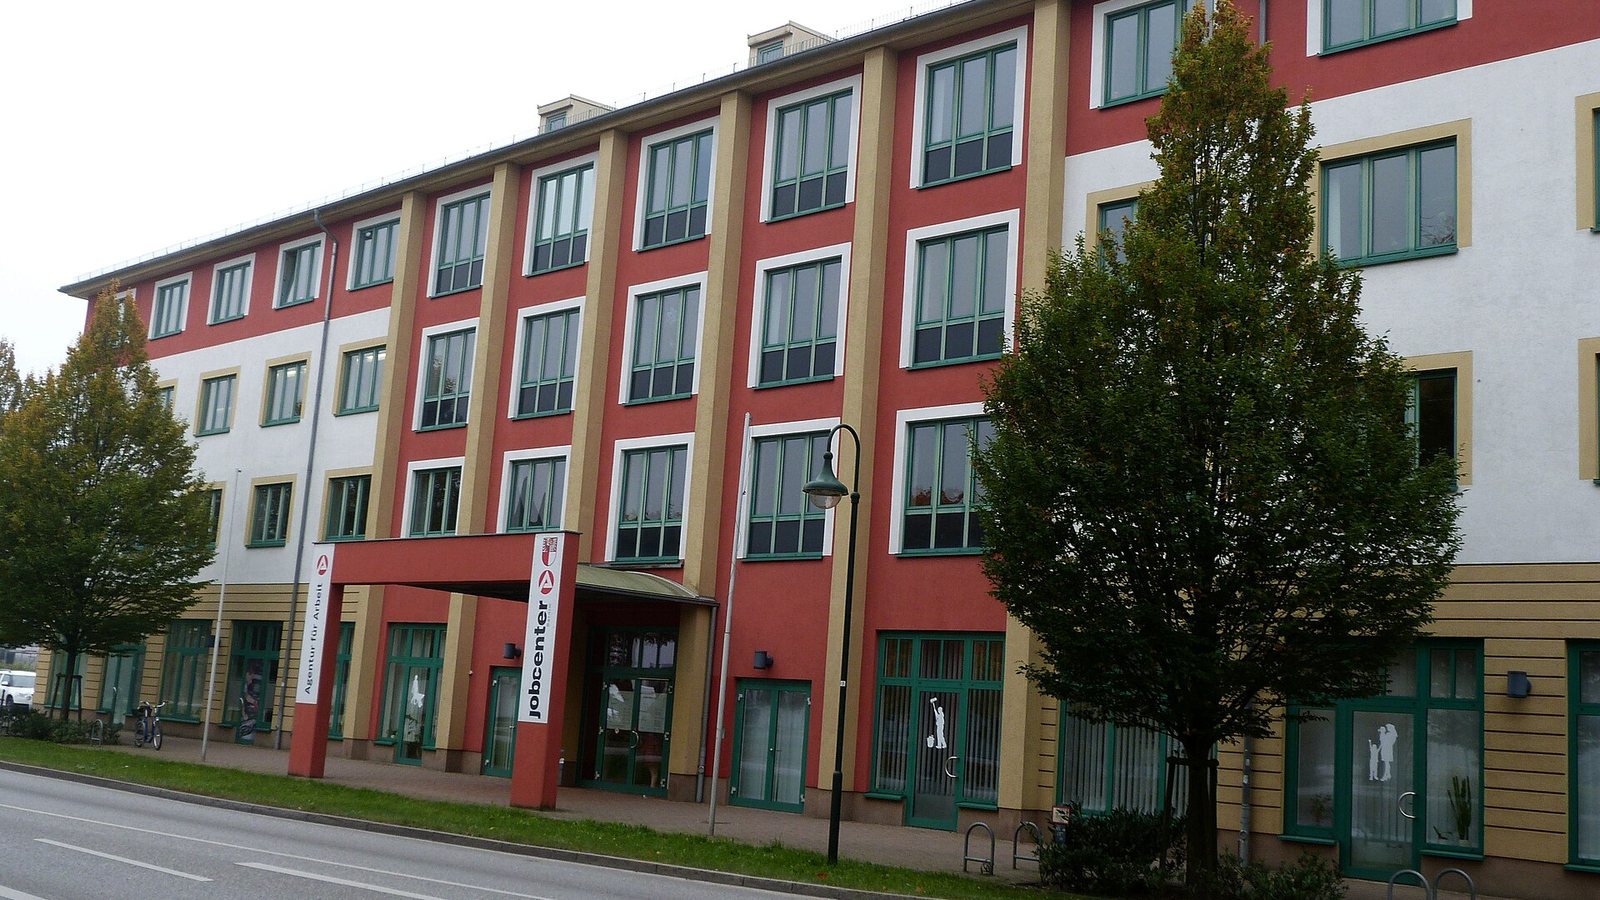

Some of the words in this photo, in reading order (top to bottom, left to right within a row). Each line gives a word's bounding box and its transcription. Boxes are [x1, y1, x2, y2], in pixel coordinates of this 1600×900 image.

[313, 583, 323, 620] Arbeit
[310, 625, 318, 641] für
[305, 646, 316, 694] Agentur
